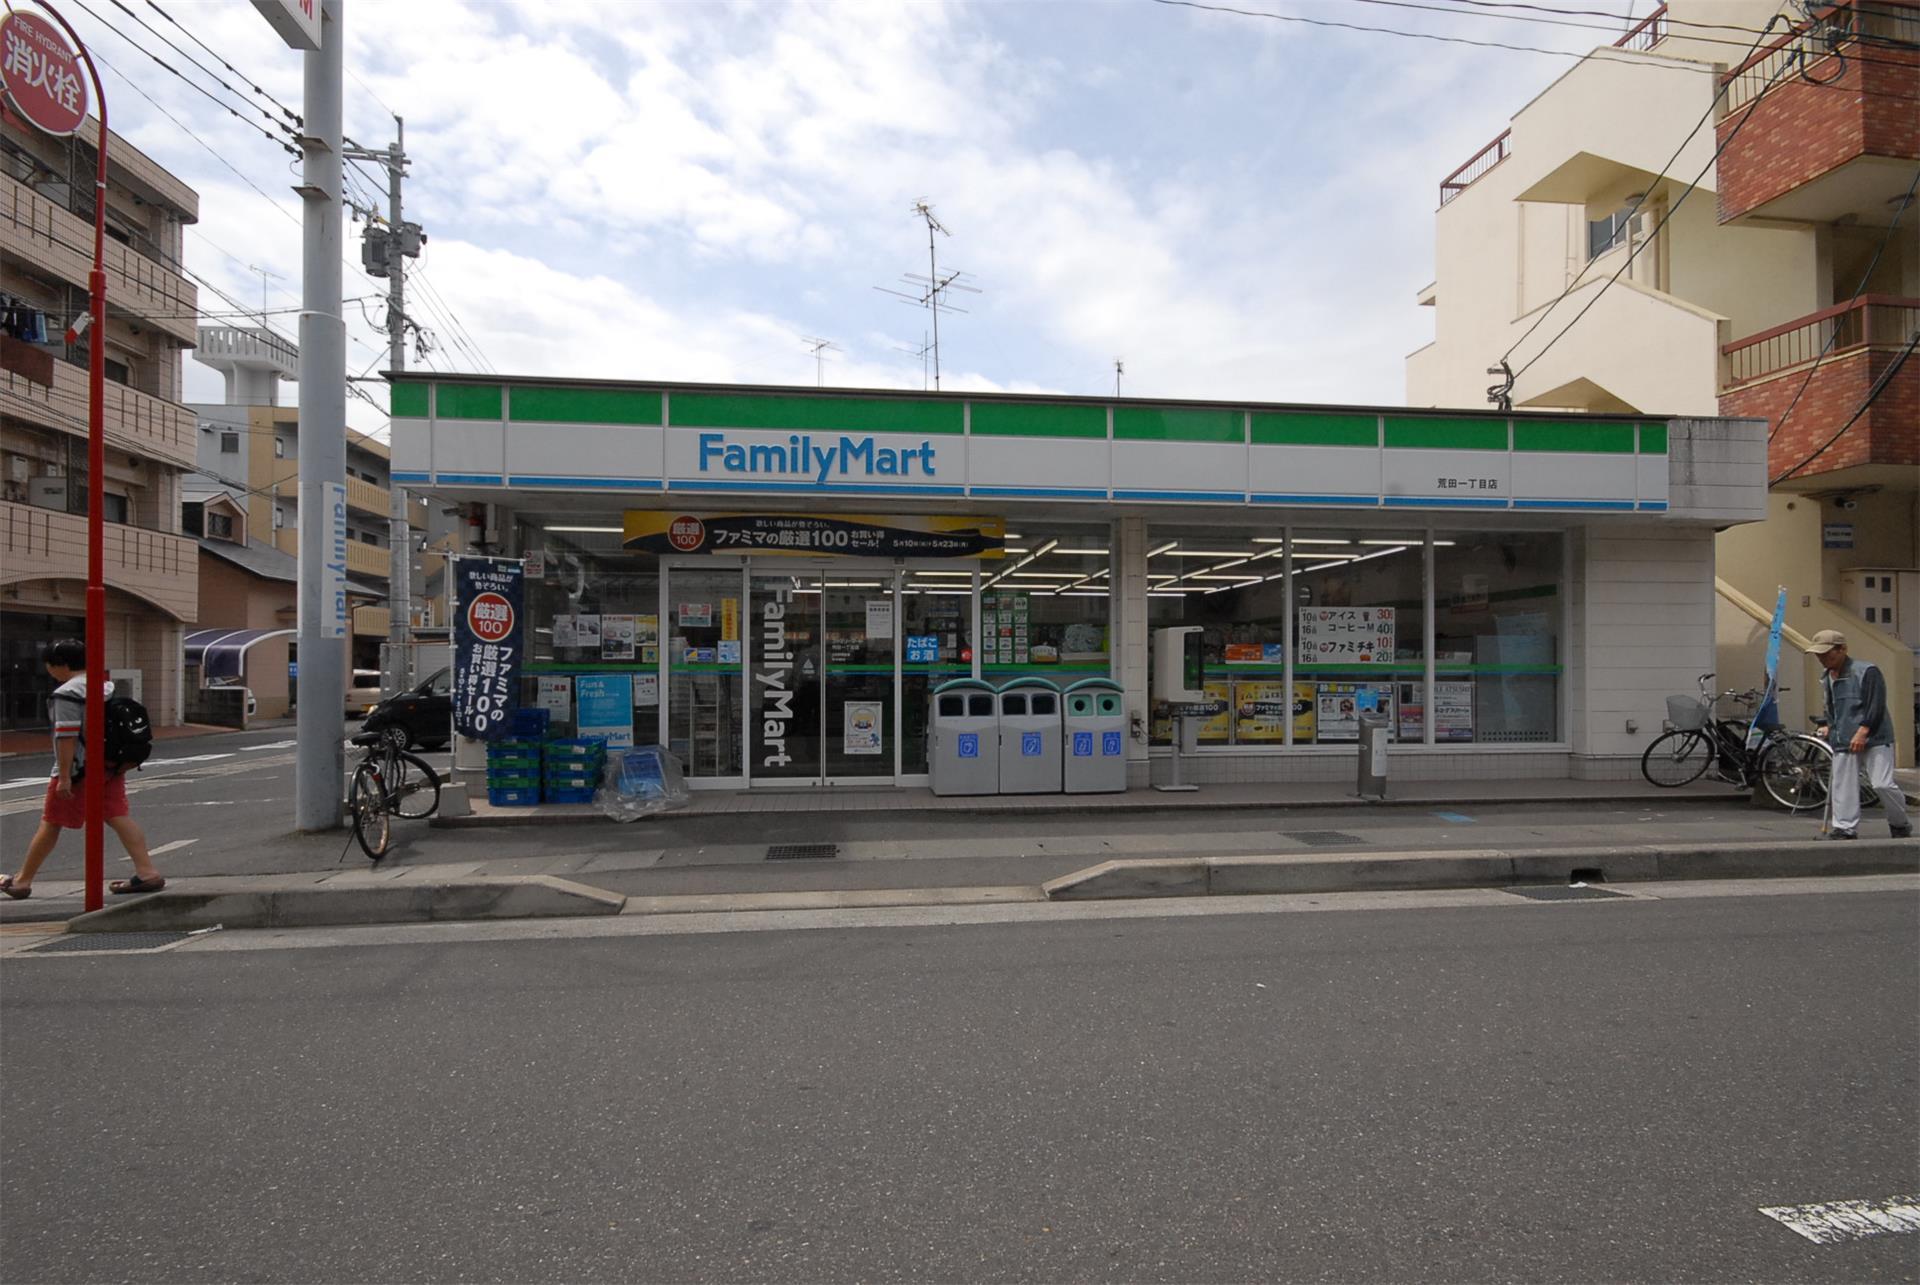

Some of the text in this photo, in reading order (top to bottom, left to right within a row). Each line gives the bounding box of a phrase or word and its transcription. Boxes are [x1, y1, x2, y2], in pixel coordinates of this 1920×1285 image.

[14, 16, 73, 65] FIRE HYDRANT
[5, 29, 80, 116] 消火栓
[699, 433, 935, 485] FamilyMart
[1437, 478, 1498, 490] 荒田一丁目店
[672, 522, 700, 535] 厳選
[676, 535, 697, 545] 100
[713, 529, 848, 547] ファミマの厳選100
[475, 602, 509, 622] 厳選
[1328, 611, 1356, 620] アイス
[478, 620, 503, 634] 100
[1377, 623, 1390, 634] 40
[907, 635, 938, 648] たばこ
[1328, 641, 1375, 653] ファミチキ
[910, 649, 936, 661] お酒
[756, 583, 794, 768] FamilyMart
[475, 644, 499, 732] 厳選100
[490, 646, 513, 722] ファミマの
